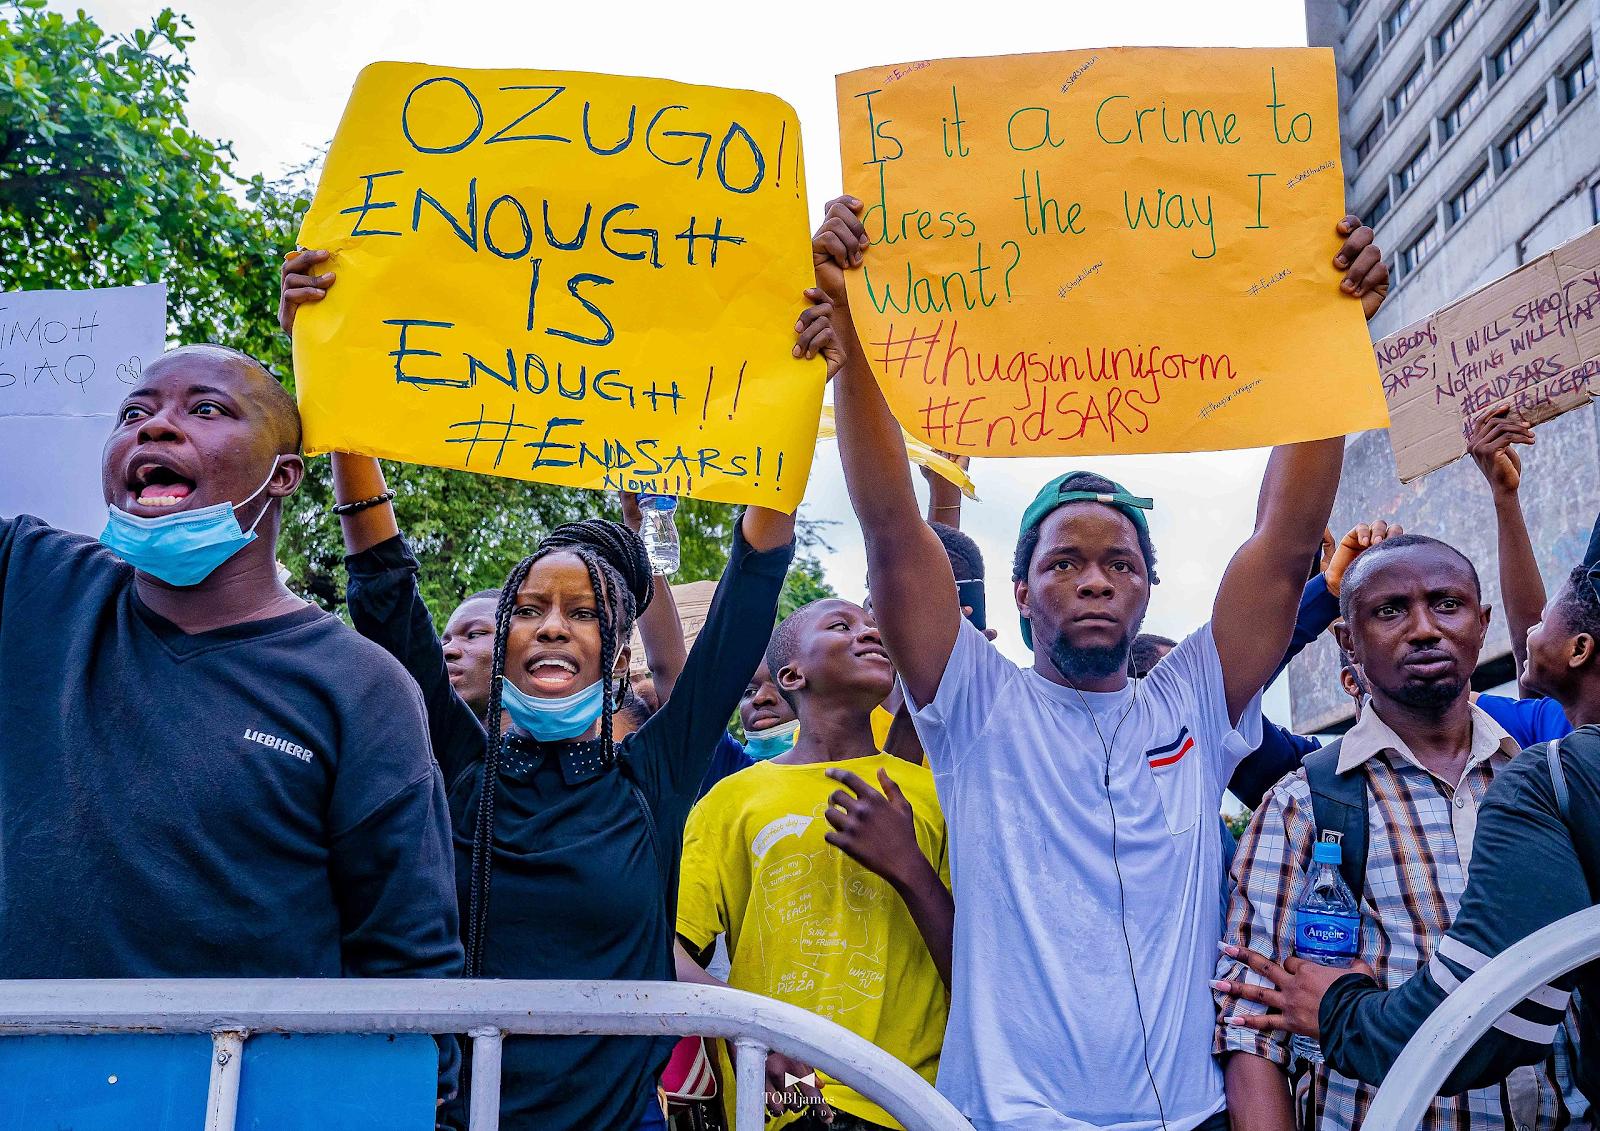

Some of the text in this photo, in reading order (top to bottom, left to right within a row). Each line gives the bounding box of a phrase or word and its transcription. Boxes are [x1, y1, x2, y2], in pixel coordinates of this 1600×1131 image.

[402, 77, 800, 199] OZUGO!!
[855, 90, 903, 164] Is
[943, 86, 969, 157] it
[1008, 108, 1064, 151] a
[1266, 67, 1312, 144] to
[340, 170, 747, 268] ENOUGH
[863, 161, 1276, 258] dress the way I
[527, 257, 615, 346] IS
[1451, 340, 1460, 367] I
[1466, 321, 1511, 356] WILL
[1512, 280, 1577, 328] SHOOT
[383, 320, 747, 429] ENOUGH!!
[1435, 349, 1504, 405] NOTHING
[1511, 322, 1556, 356] WILL
[1461, 353, 1564, 415] #ENDSARS
[918, 386, 1148, 447] #EndSARS
[244, 729, 314, 763] LIEBHERR
[852, 880, 878, 901] SUN
[777, 979, 814, 994] PIZZA
[781, 972, 796, 981] eat
[849, 967, 885, 982] WATCH
[859, 978, 872, 989] TV
